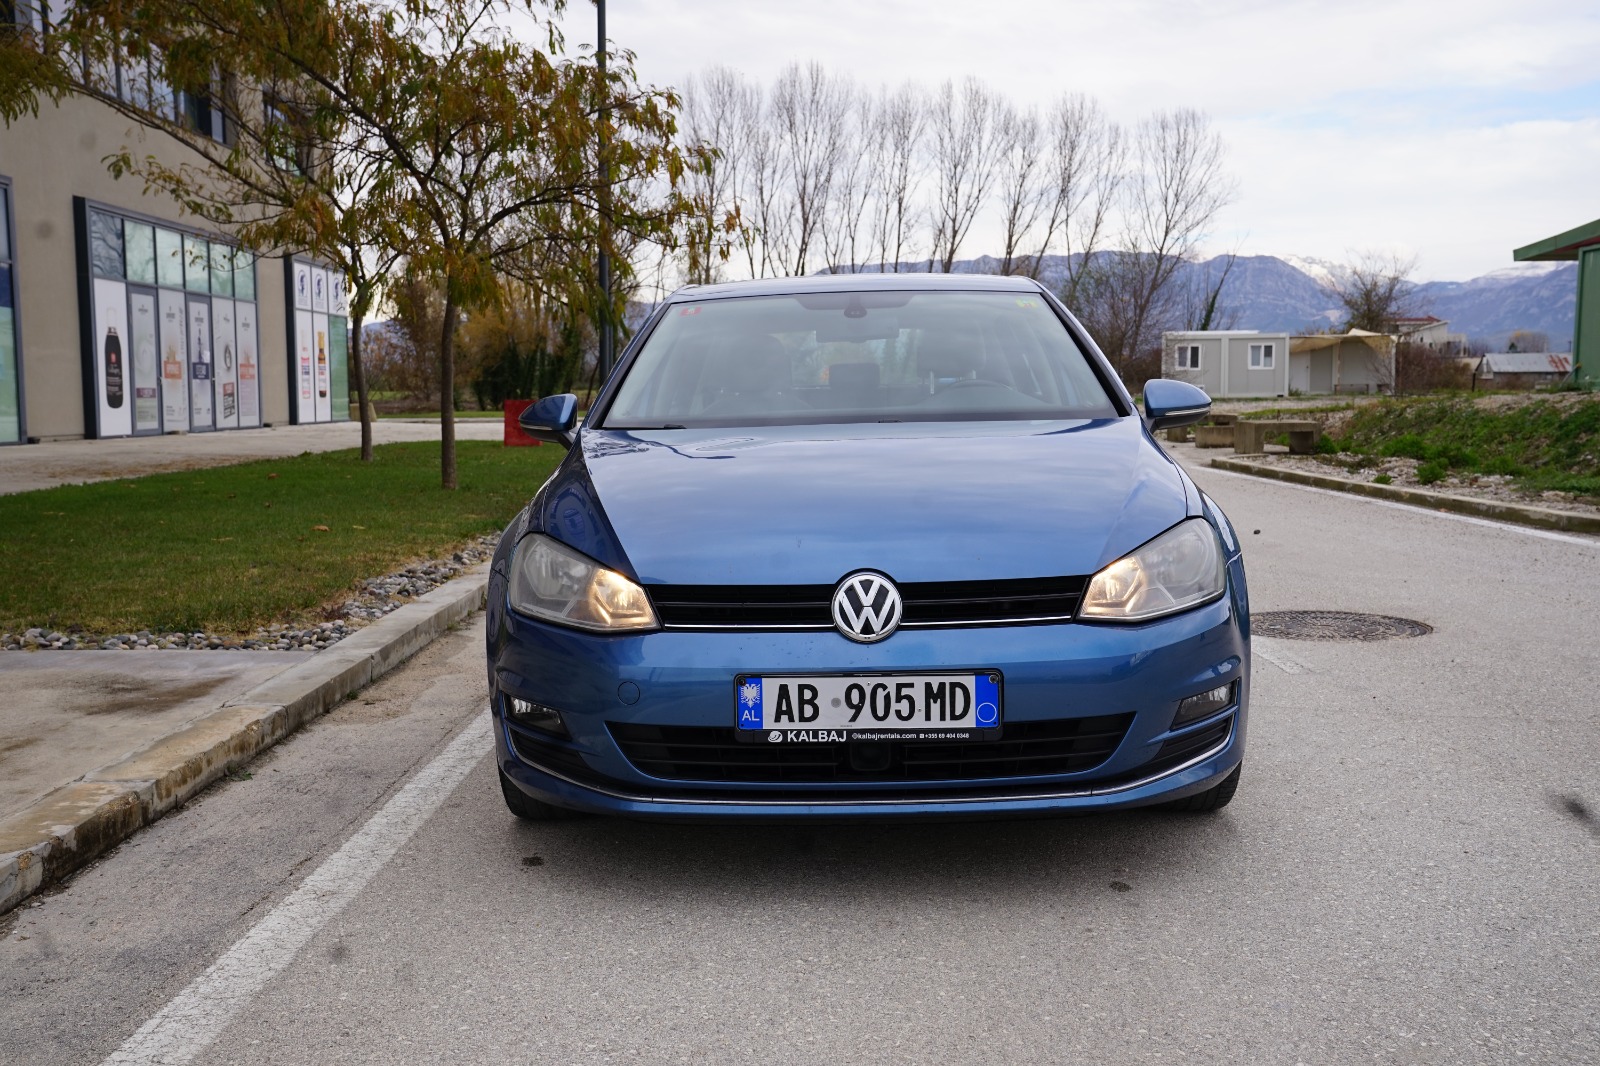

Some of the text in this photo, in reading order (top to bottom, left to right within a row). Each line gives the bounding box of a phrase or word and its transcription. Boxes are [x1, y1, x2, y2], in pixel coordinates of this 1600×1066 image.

[773, 681, 971, 723] AB 905 MD
[741, 709, 760, 722] AL
[787, 730, 847, 742] KALBAJ
